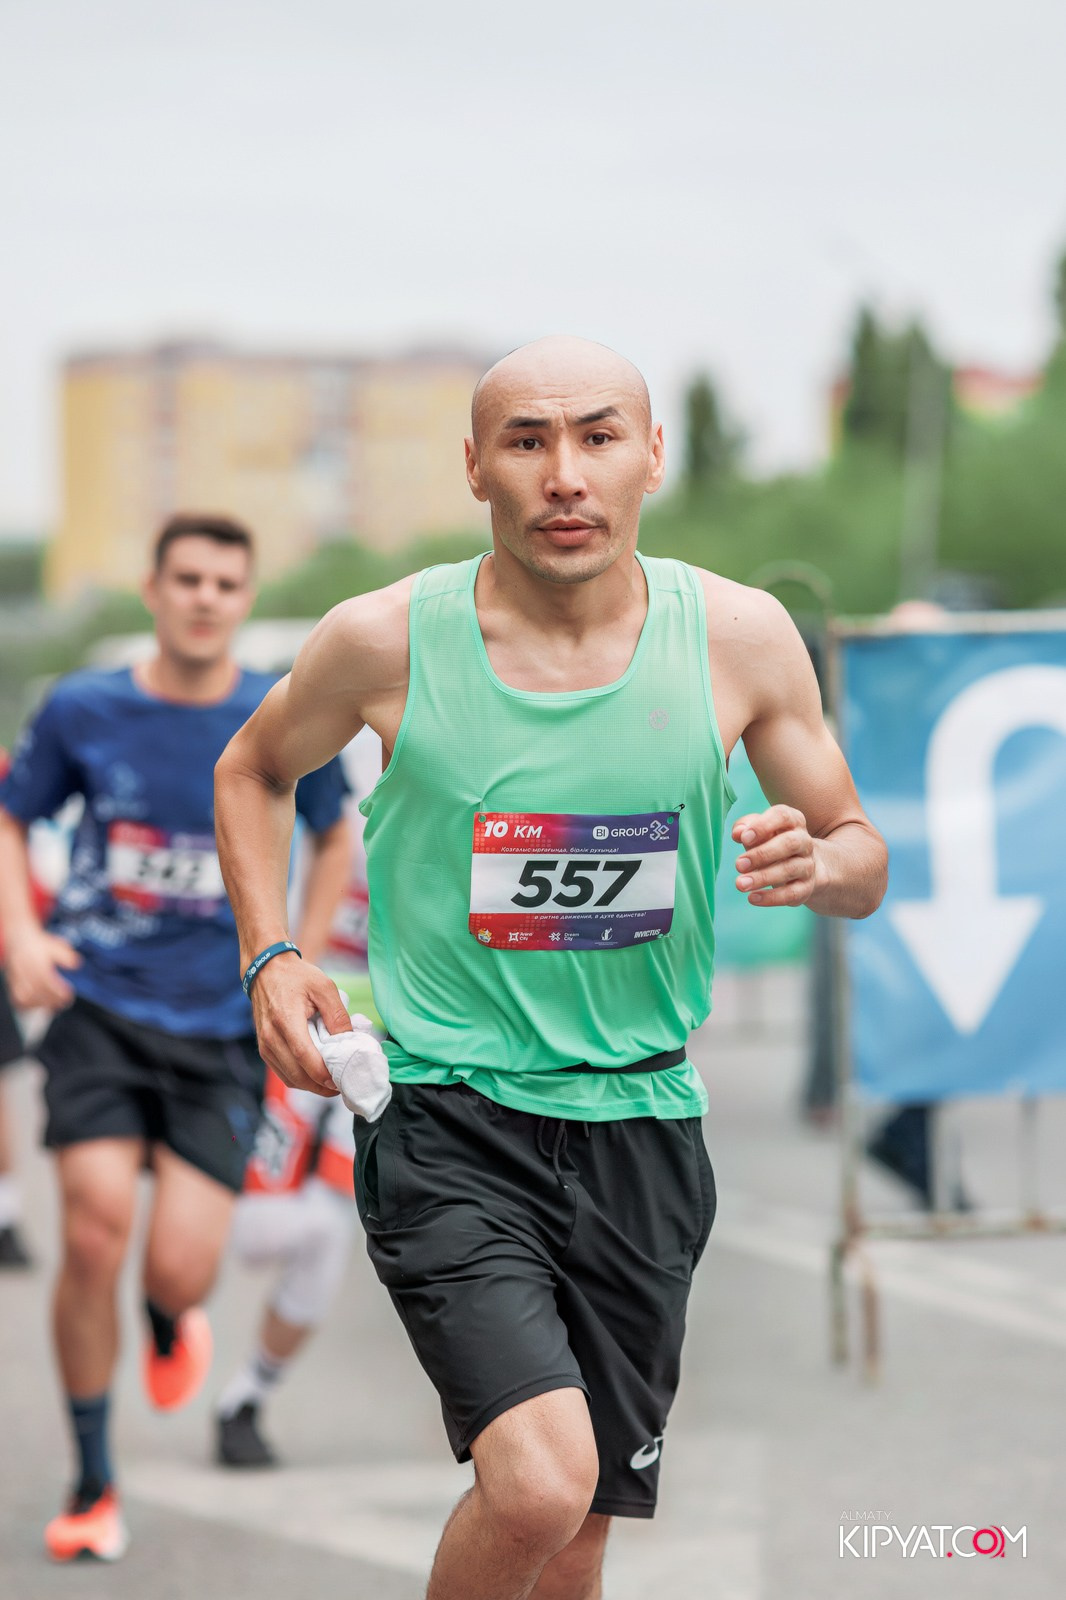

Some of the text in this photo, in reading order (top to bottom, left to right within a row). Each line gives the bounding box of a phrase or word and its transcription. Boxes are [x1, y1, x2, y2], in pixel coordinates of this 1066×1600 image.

[484, 821, 543, 839] 10 KM
[610, 827, 648, 838] GROUP
[510, 860, 642, 908] 557
